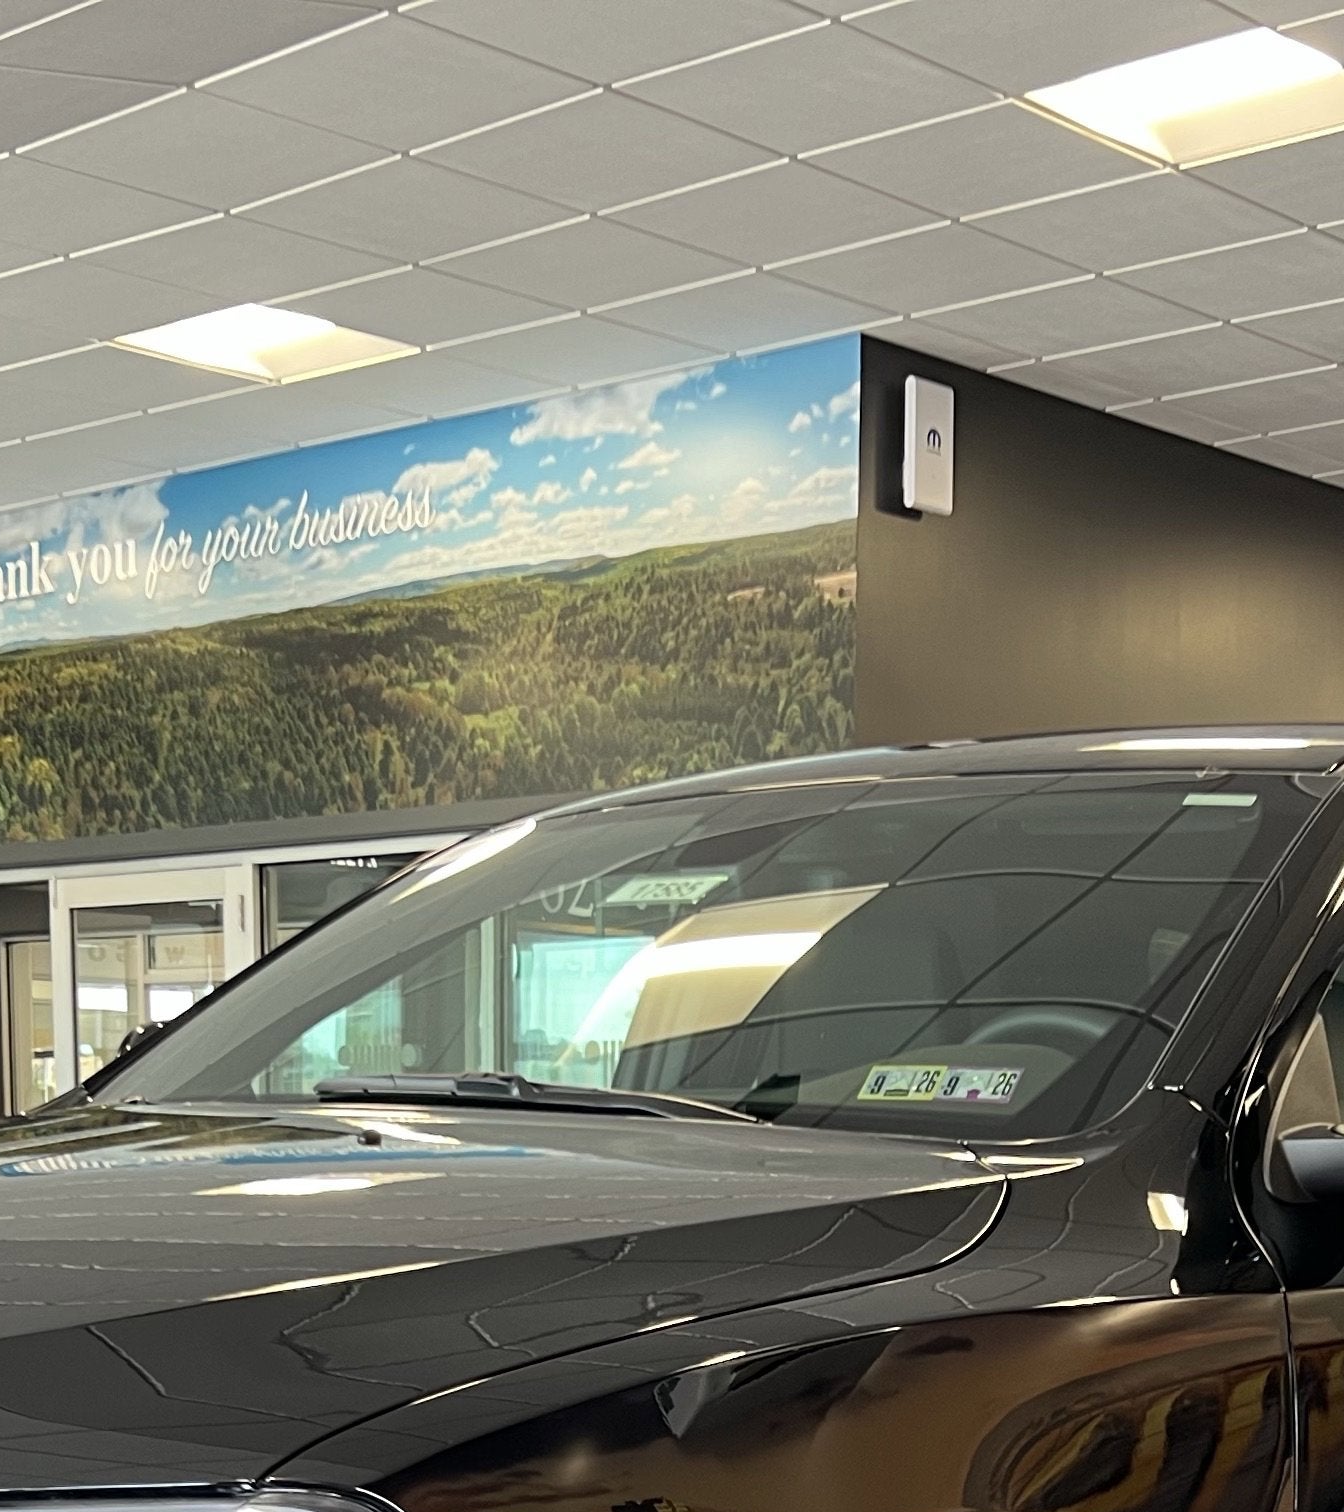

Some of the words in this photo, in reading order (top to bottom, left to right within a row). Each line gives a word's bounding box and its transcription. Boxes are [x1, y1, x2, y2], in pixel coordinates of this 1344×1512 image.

[66, 539, 138, 605] you
[145, 520, 193, 599] for
[199, 515, 280, 594] your
[289, 485, 435, 550] business
[914, 1070, 941, 1094] 26
[991, 1072, 1017, 1097] 26
